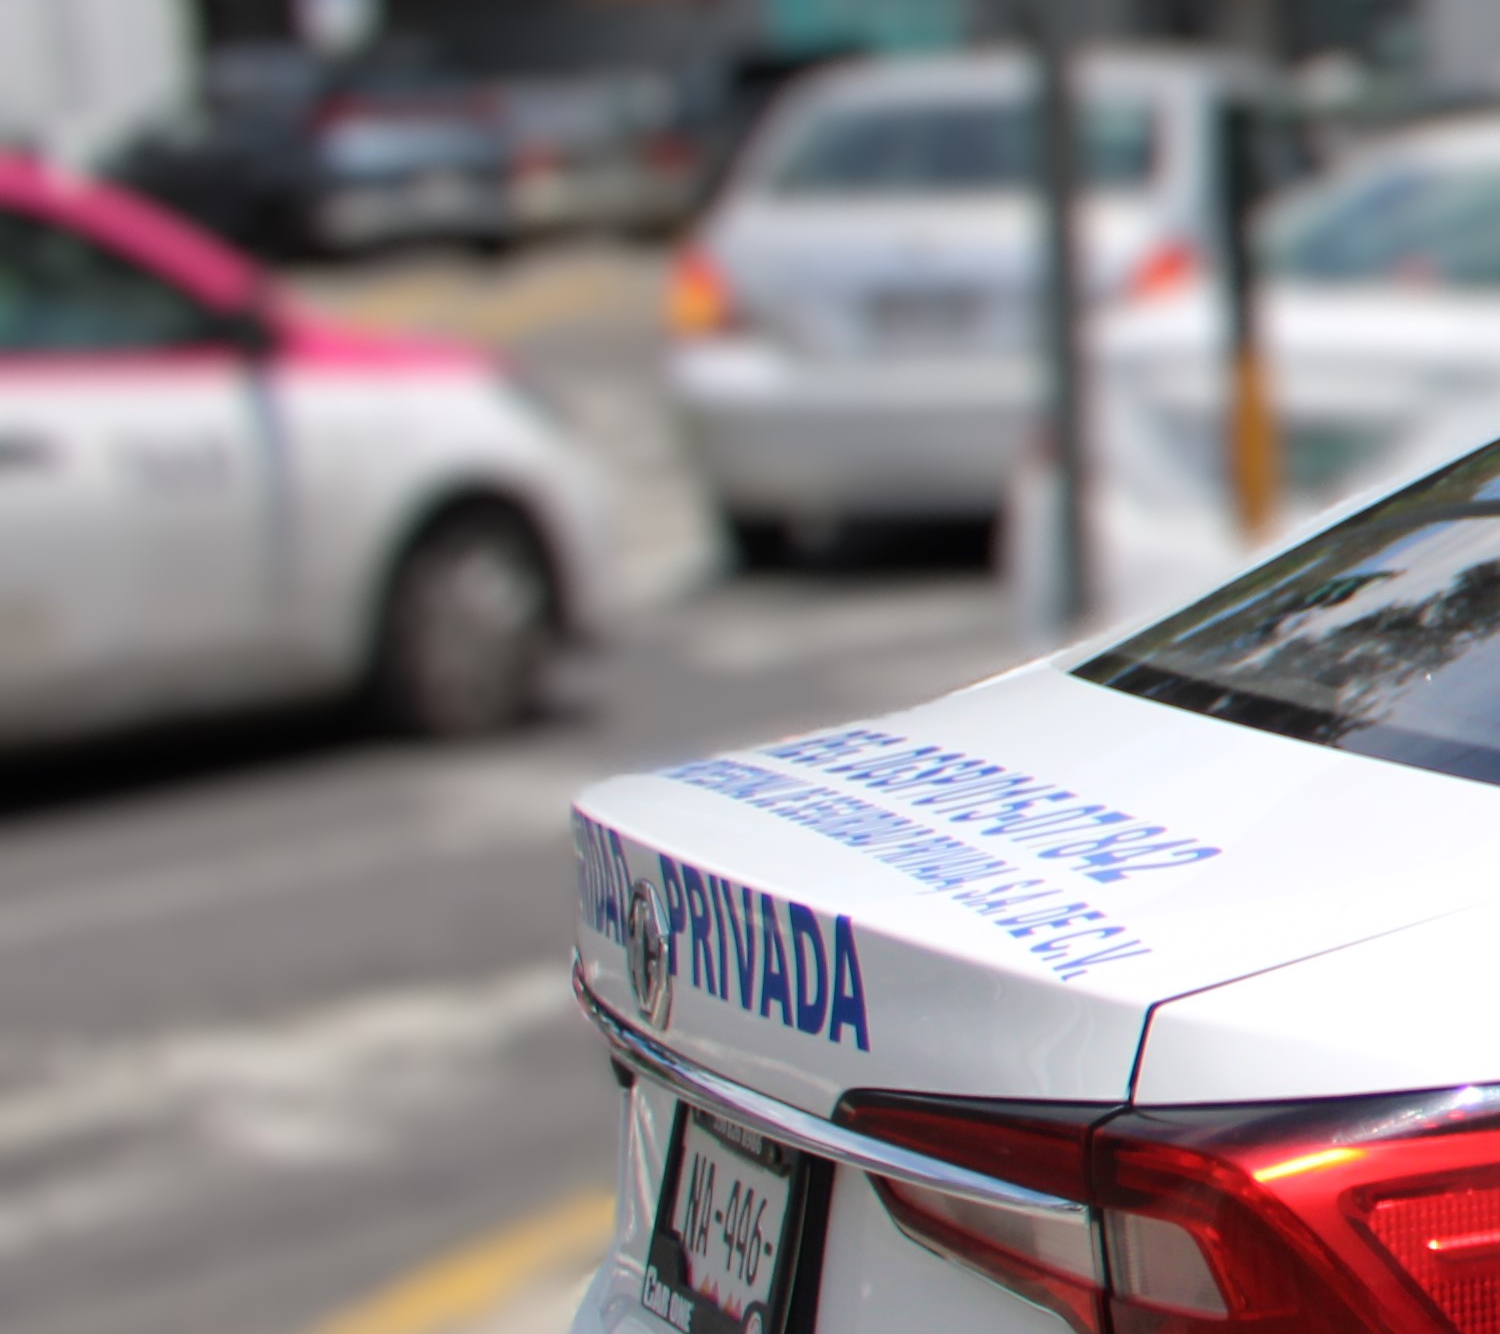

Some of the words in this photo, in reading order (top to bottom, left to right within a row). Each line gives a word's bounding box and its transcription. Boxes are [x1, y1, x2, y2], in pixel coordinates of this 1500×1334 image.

[659, 853, 870, 1053] PRIVADA
[994, 901, 1106, 938] DE
[1030, 925, 1152, 982] C.V.
[683, 1152, 773, 1286] NA-446-
